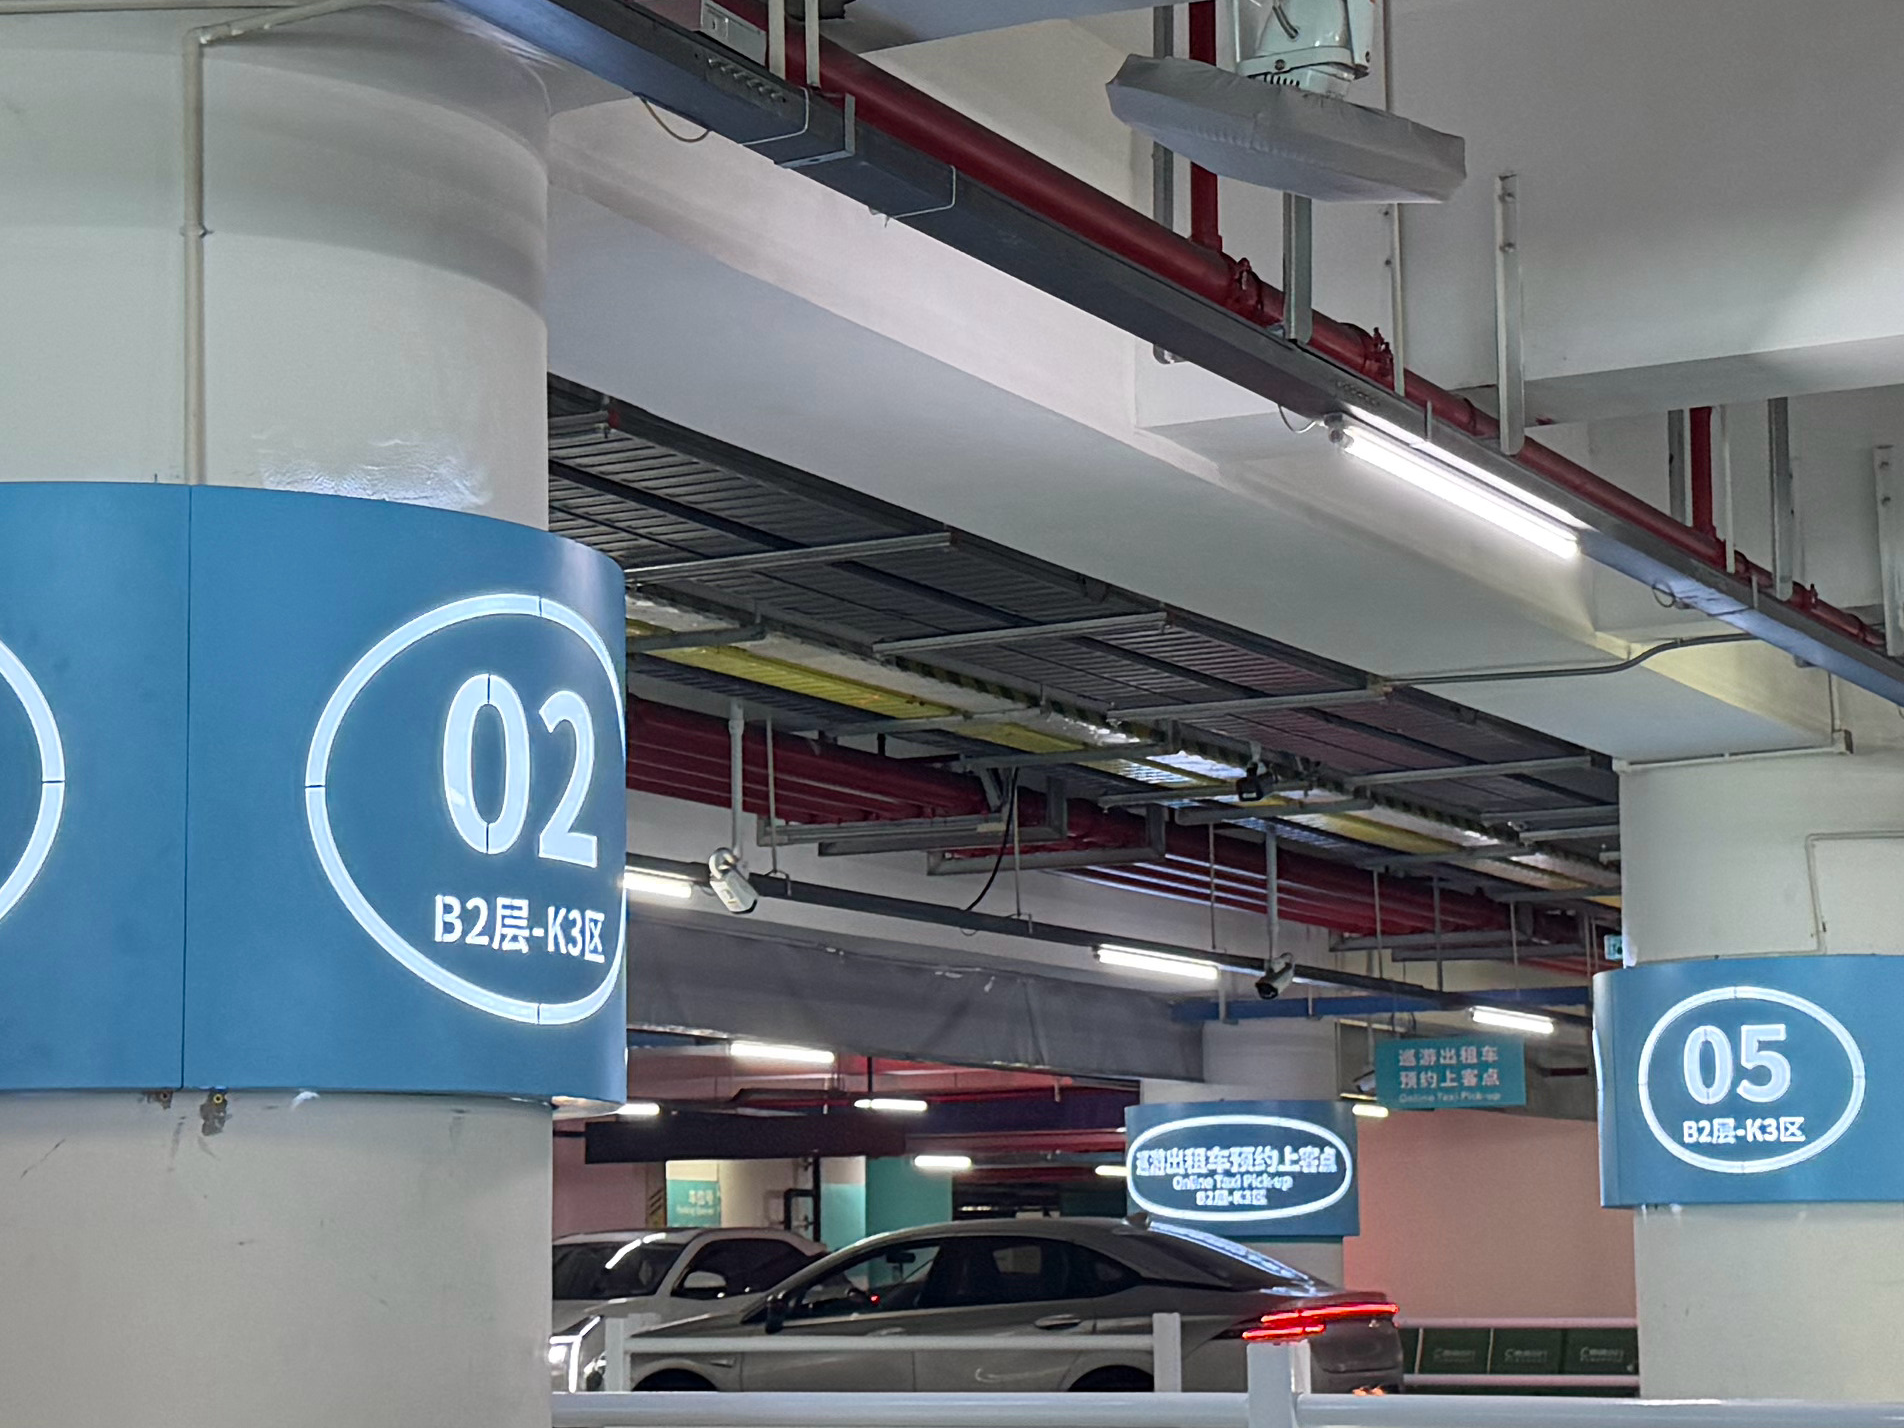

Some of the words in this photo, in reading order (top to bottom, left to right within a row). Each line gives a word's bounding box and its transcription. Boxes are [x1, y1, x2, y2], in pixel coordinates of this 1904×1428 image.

[442, 672, 599, 869] 02
[434, 893, 606, 964] B2层-K3区
[1398, 1045, 1499, 1067] 巡游出租车
[1399, 1068, 1501, 1089] 预约上客点
[1683, 1023, 1792, 1105] 05
[1683, 1116, 1807, 1145] B2层-K3区
